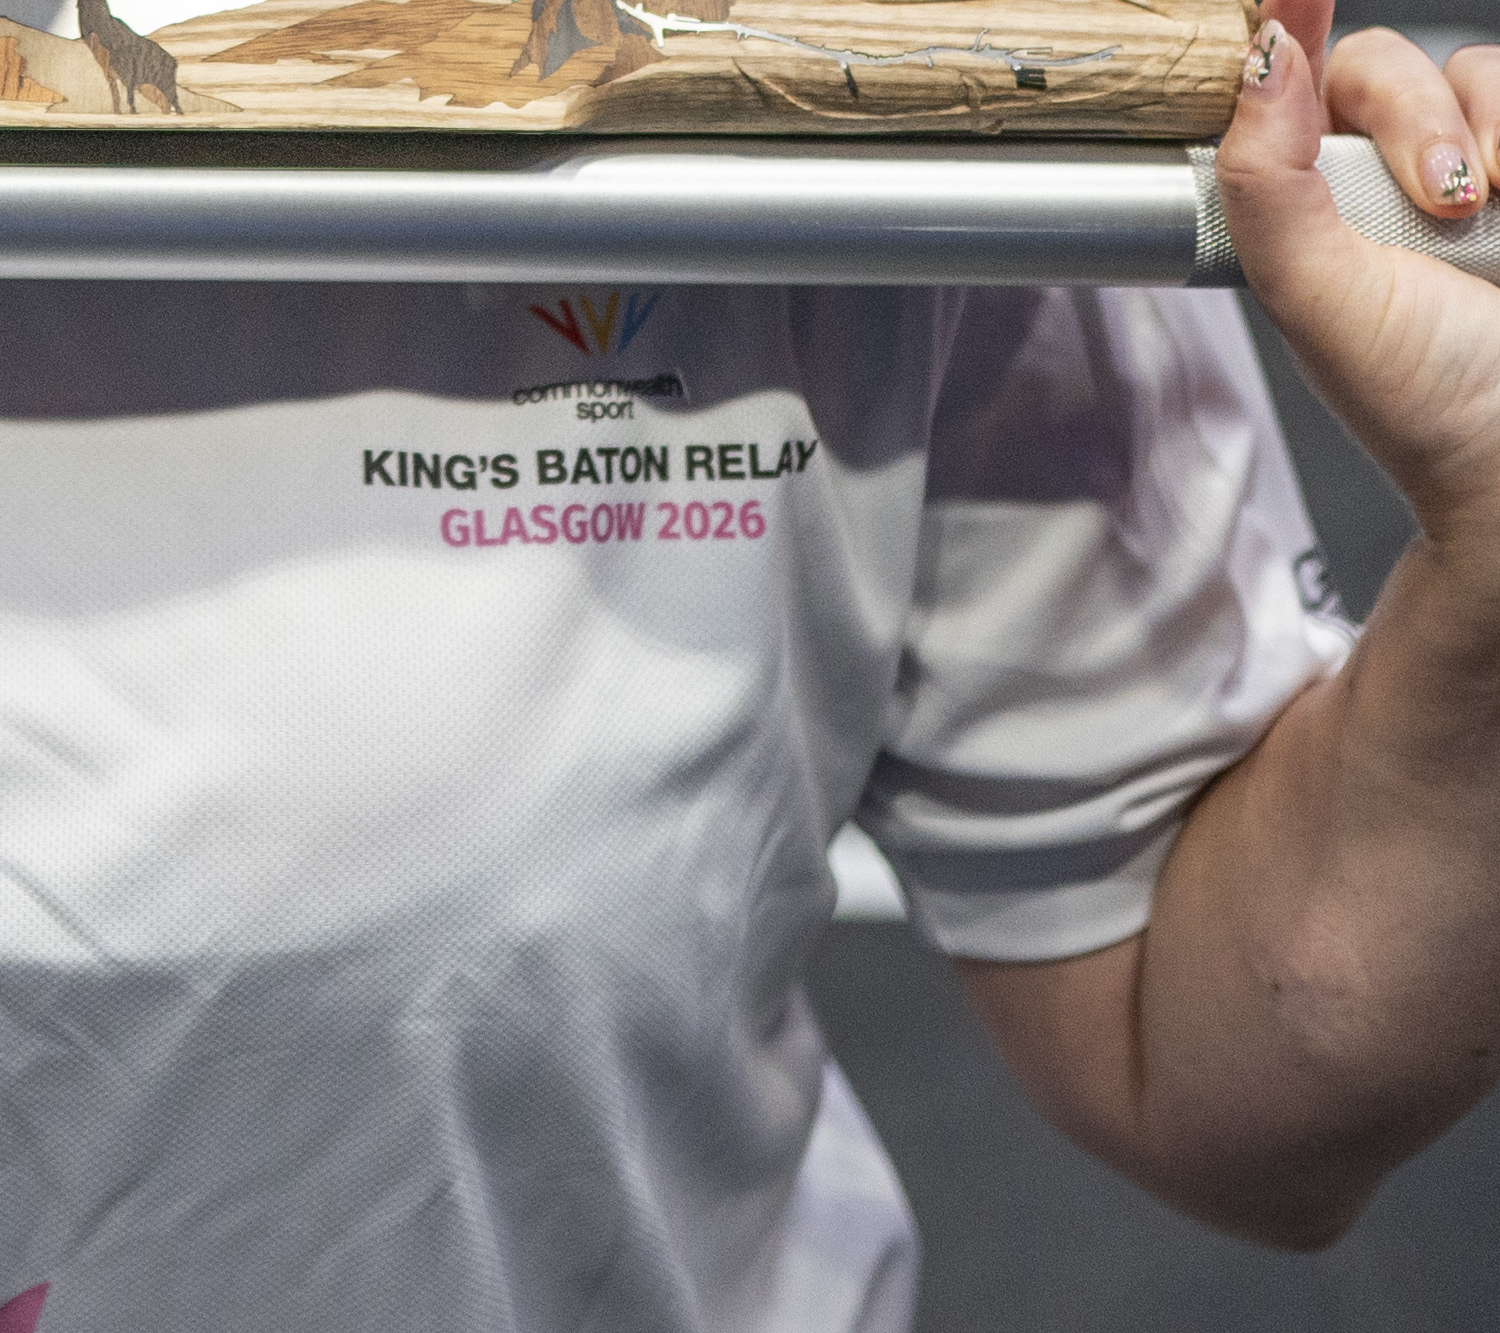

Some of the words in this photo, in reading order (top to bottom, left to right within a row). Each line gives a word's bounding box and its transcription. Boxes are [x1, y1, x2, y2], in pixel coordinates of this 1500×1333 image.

[576, 399, 635, 423] sport
[362, 448, 521, 491] KING'S
[536, 444, 670, 486] BATON
[685, 438, 818, 482] RELAY
[440, 501, 647, 547] GLASGOW
[657, 499, 767, 541] 2026
